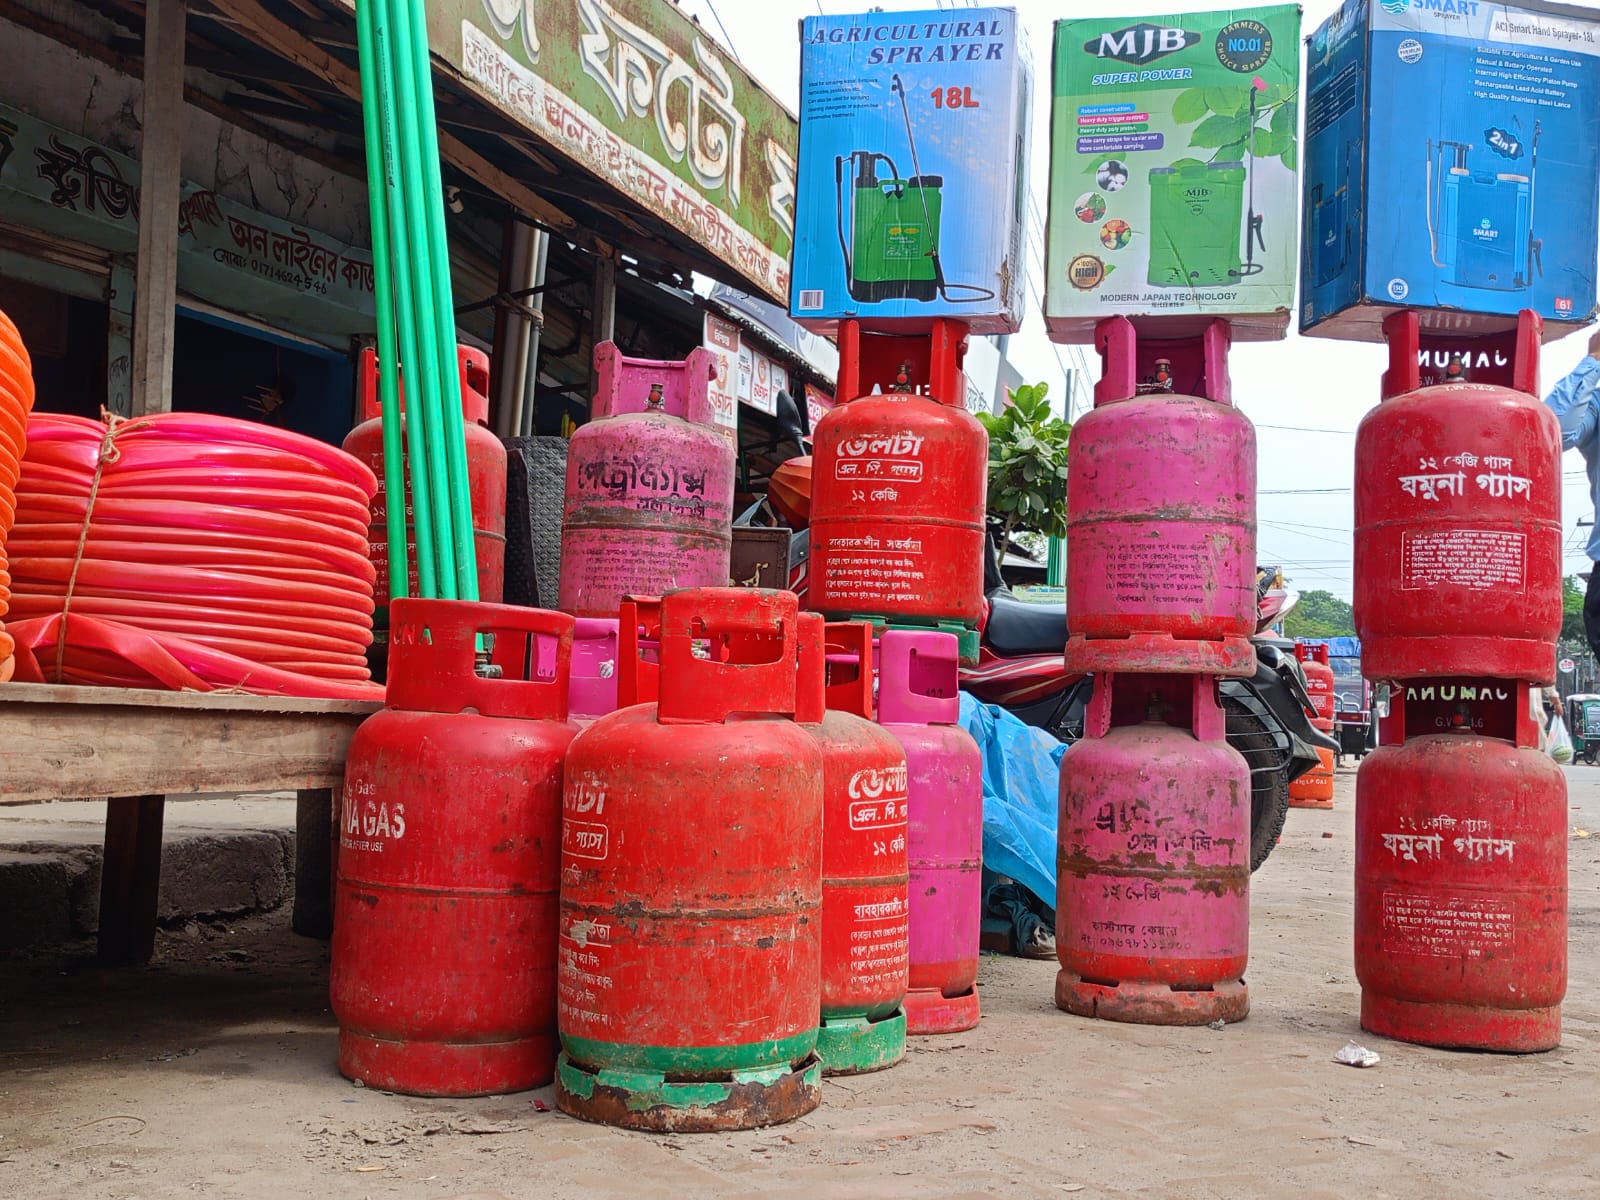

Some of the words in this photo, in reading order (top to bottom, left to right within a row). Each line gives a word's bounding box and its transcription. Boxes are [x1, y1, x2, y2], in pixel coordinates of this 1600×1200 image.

[810, 20, 1004, 44] AGRICULTURAL
[1223, 21, 1265, 35] FARMERS
[1495, 21, 1507, 33] ACI
[1509, 22, 1532, 35] Smart
[1532, 24, 1551, 37] Hand
[1097, 27, 1186, 58] MJB
[1228, 38, 1261, 52] NO.01
[867, 43, 1004, 64] SPRAYER
[1477, 46, 1501, 55] Suitable
[1502, 49, 1510, 57] for
[1511, 51, 1543, 61] Agriculture
[1550, 56, 1570, 65] Garden
[1571, 59, 1582, 67] Use
[1476, 57, 1497, 66] Manual
[1504, 61, 1526, 71] Battery
[1526, 64, 1553, 73] Operated
[1092, 73, 1138, 85] SUPER
[1140, 68, 1192, 82] POWER
[1475, 68, 1498, 77] Internal
[1498, 70, 1512, 80] High
[1513, 73, 1542, 84] Efficiency
[1542, 77, 1561, 86] Piston
[1561, 80, 1578, 89] Pump
[1474, 79, 1514, 90] Rechargeable
[1515, 83, 1530, 92] Lead
[1530, 85, 1544, 94] Acid
[1545, 87, 1566, 98] Battery
[930, 87, 979, 109] 18L
[1474, 90, 1488, 98] High
[1488, 92, 1510, 102] Quality
[1510, 95, 1537, 104] Stainless
[1538, 98, 1553, 106] Steel
[1473, 227, 1498, 238] SMART
[227, 215, 269, 258] অন
[271, 226, 339, 284] লাইনের
[1075, 267, 1097, 279] HIGH
[1100, 292, 1140, 303] MODERN
[1141, 292, 1172, 302] JAPAN
[1174, 290, 1238, 302] TECHNOLOGY
[1419, 457, 1439, 471] ১২
[1483, 455, 1513, 472] গ্যাস
[1397, 470, 1468, 502] যমুনা
[1475, 470, 1534, 502] গ্যাস
[851, 489, 866, 503] ১২
[870, 488, 898, 503] কেজি
[363, 800, 406, 840] GAS
[370, 841, 384, 853] USE
[873, 840, 887, 857] ১২
[1381, 832, 1445, 864] যমুনা
[1453, 833, 1517, 864] গ্যাস
